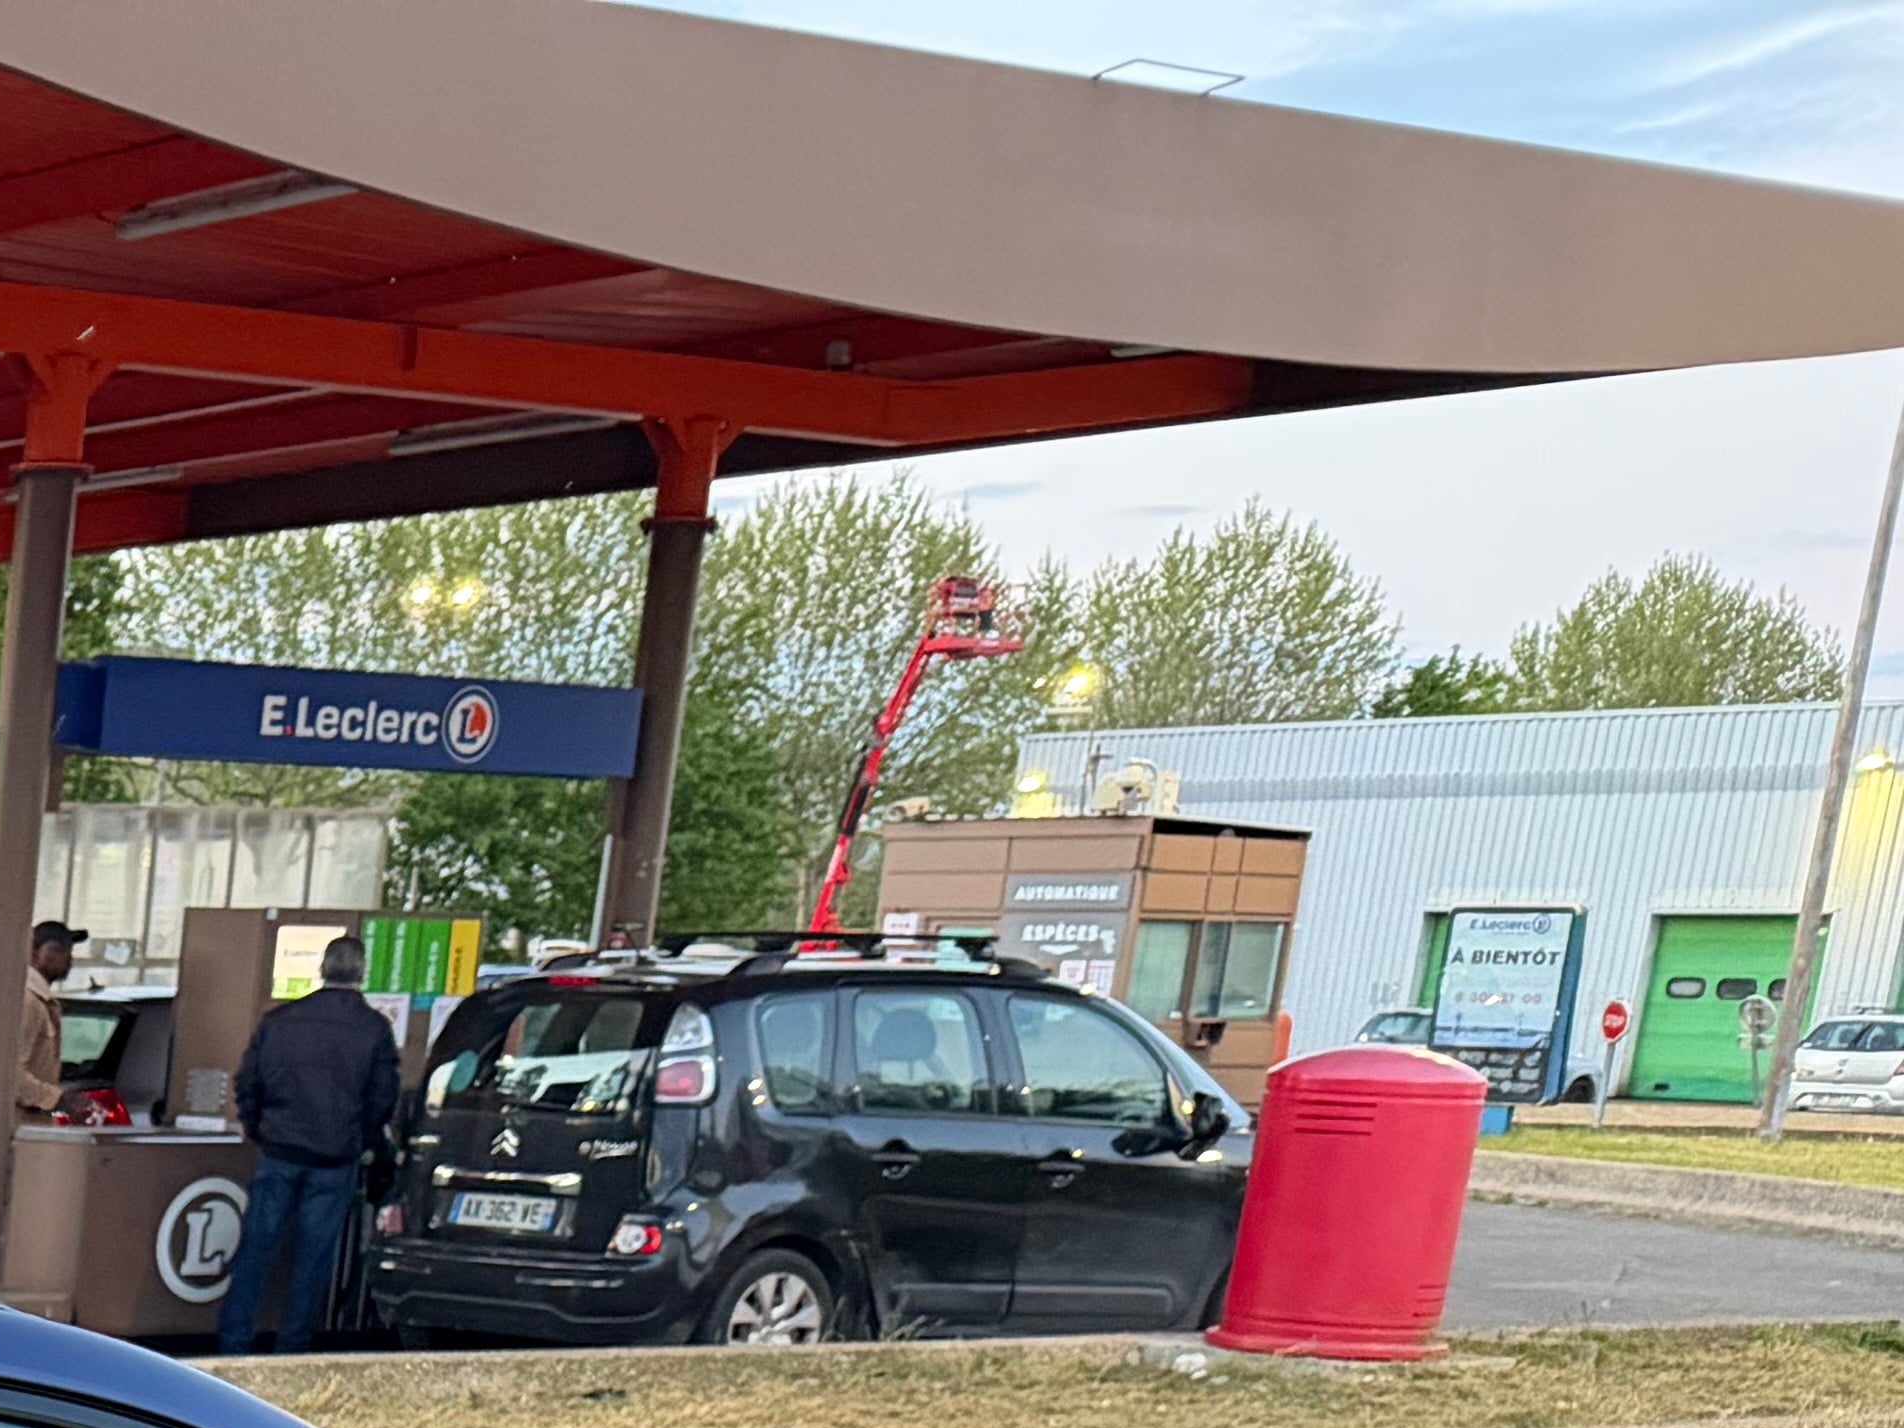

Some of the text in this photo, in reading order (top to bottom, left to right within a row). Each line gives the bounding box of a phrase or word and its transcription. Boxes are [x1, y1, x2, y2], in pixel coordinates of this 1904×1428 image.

[260, 694, 440, 745] E.Leclerc
[1013, 884, 1119, 901] AUTOMATIQUE
[1021, 921, 1100, 942] ESPÈCES
[1469, 917, 1532, 932] E.Leclerc
[1450, 947, 1562, 967] À BIENTÔT
